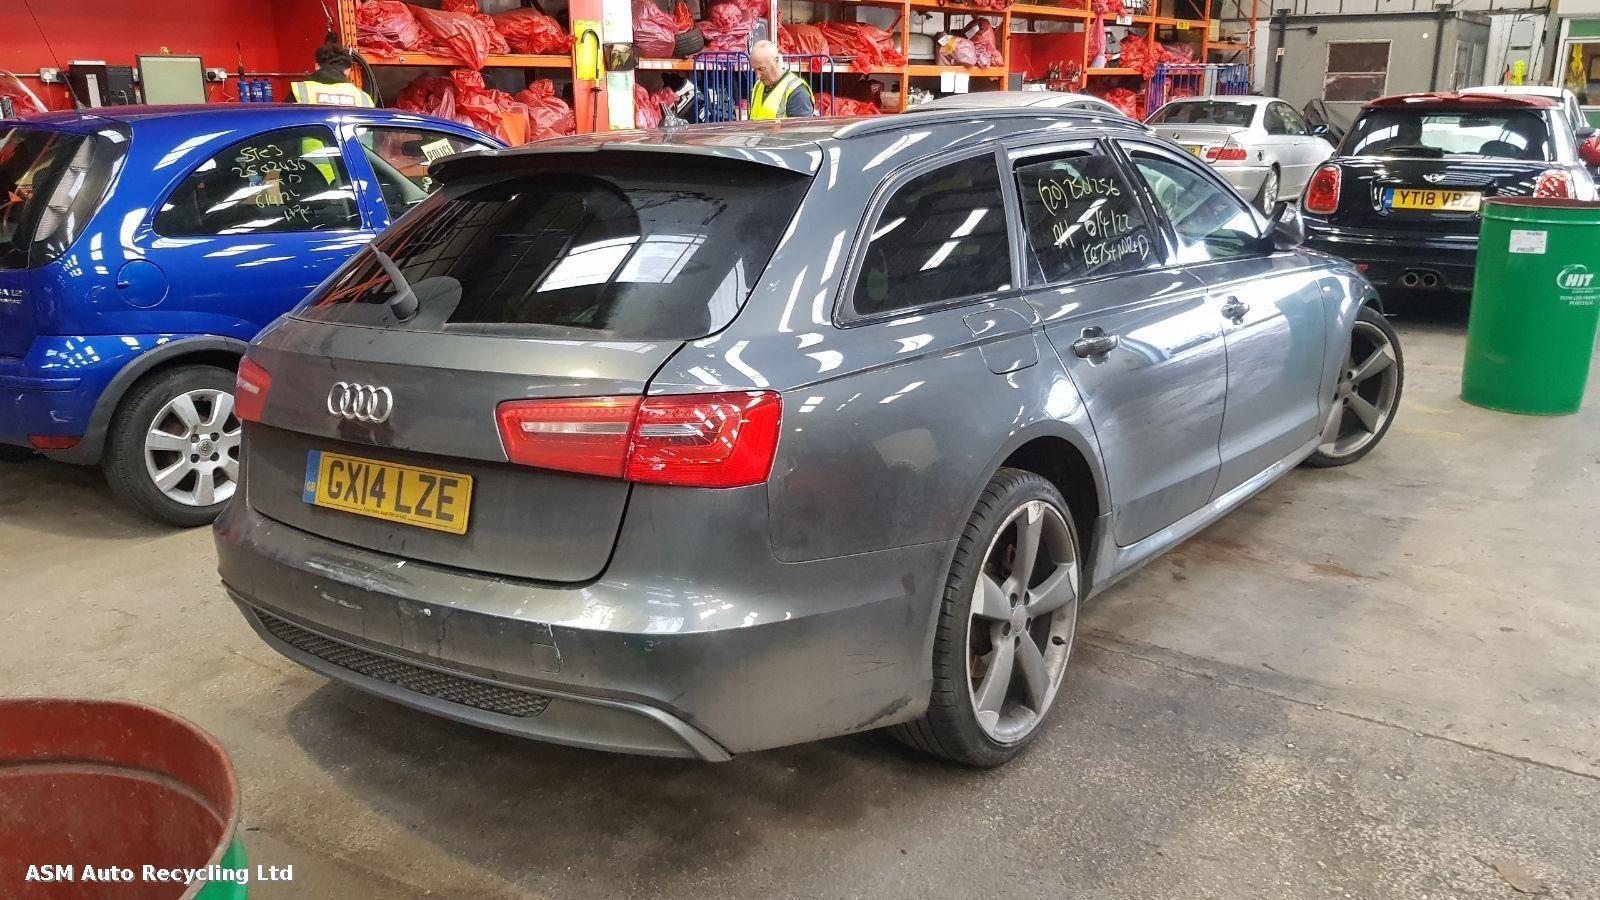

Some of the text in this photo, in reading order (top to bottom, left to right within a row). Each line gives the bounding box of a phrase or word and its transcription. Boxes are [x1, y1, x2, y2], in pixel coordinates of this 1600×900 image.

[1400, 190, 1436, 206] YT18
[1564, 273, 1594, 287] HIT
[327, 459, 459, 522] GX14 LZE
